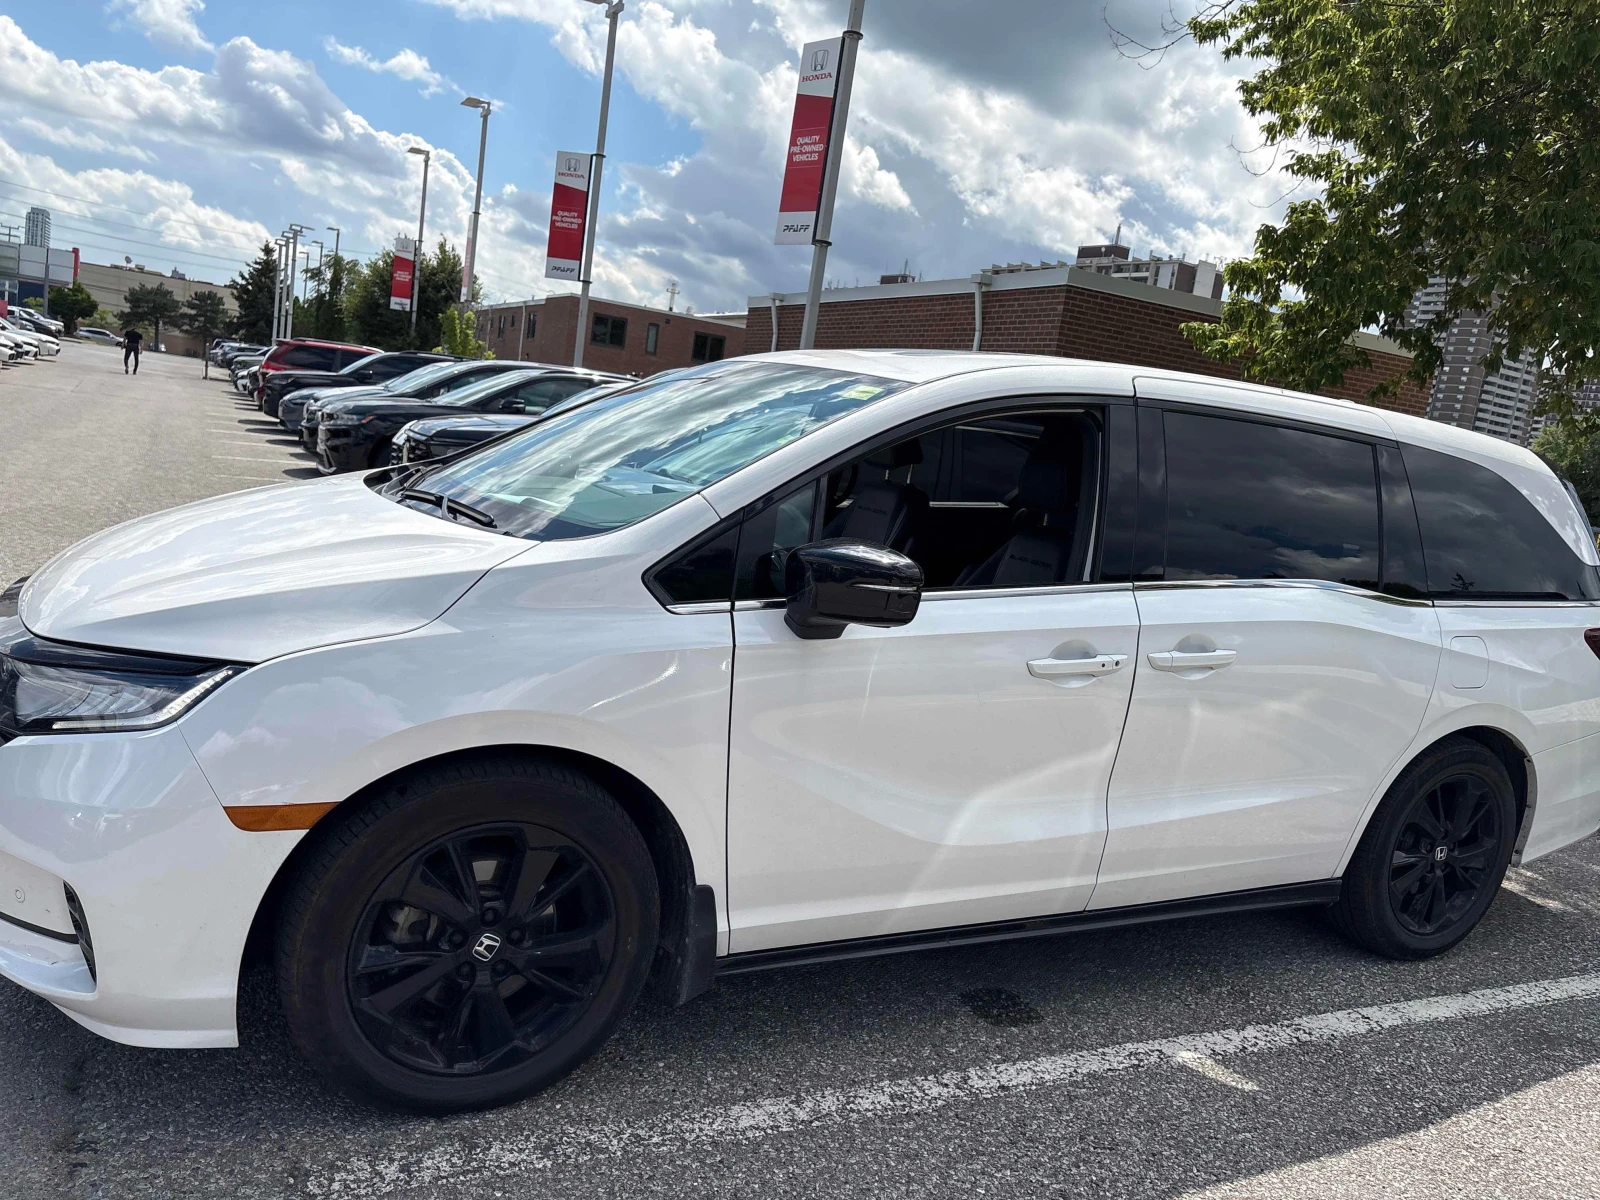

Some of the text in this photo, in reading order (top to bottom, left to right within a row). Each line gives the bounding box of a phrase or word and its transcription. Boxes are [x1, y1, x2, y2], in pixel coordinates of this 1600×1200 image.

[801, 72, 832, 82] HONDA
[797, 135, 820, 145] QUALITY
[790, 144, 824, 154] PRE-OWNED
[793, 153, 819, 162] VEHICLES
[552, 216, 582, 224] PRE-OWNED
[782, 224, 810, 233] PFAFF
[551, 265, 575, 273] PFAFF
